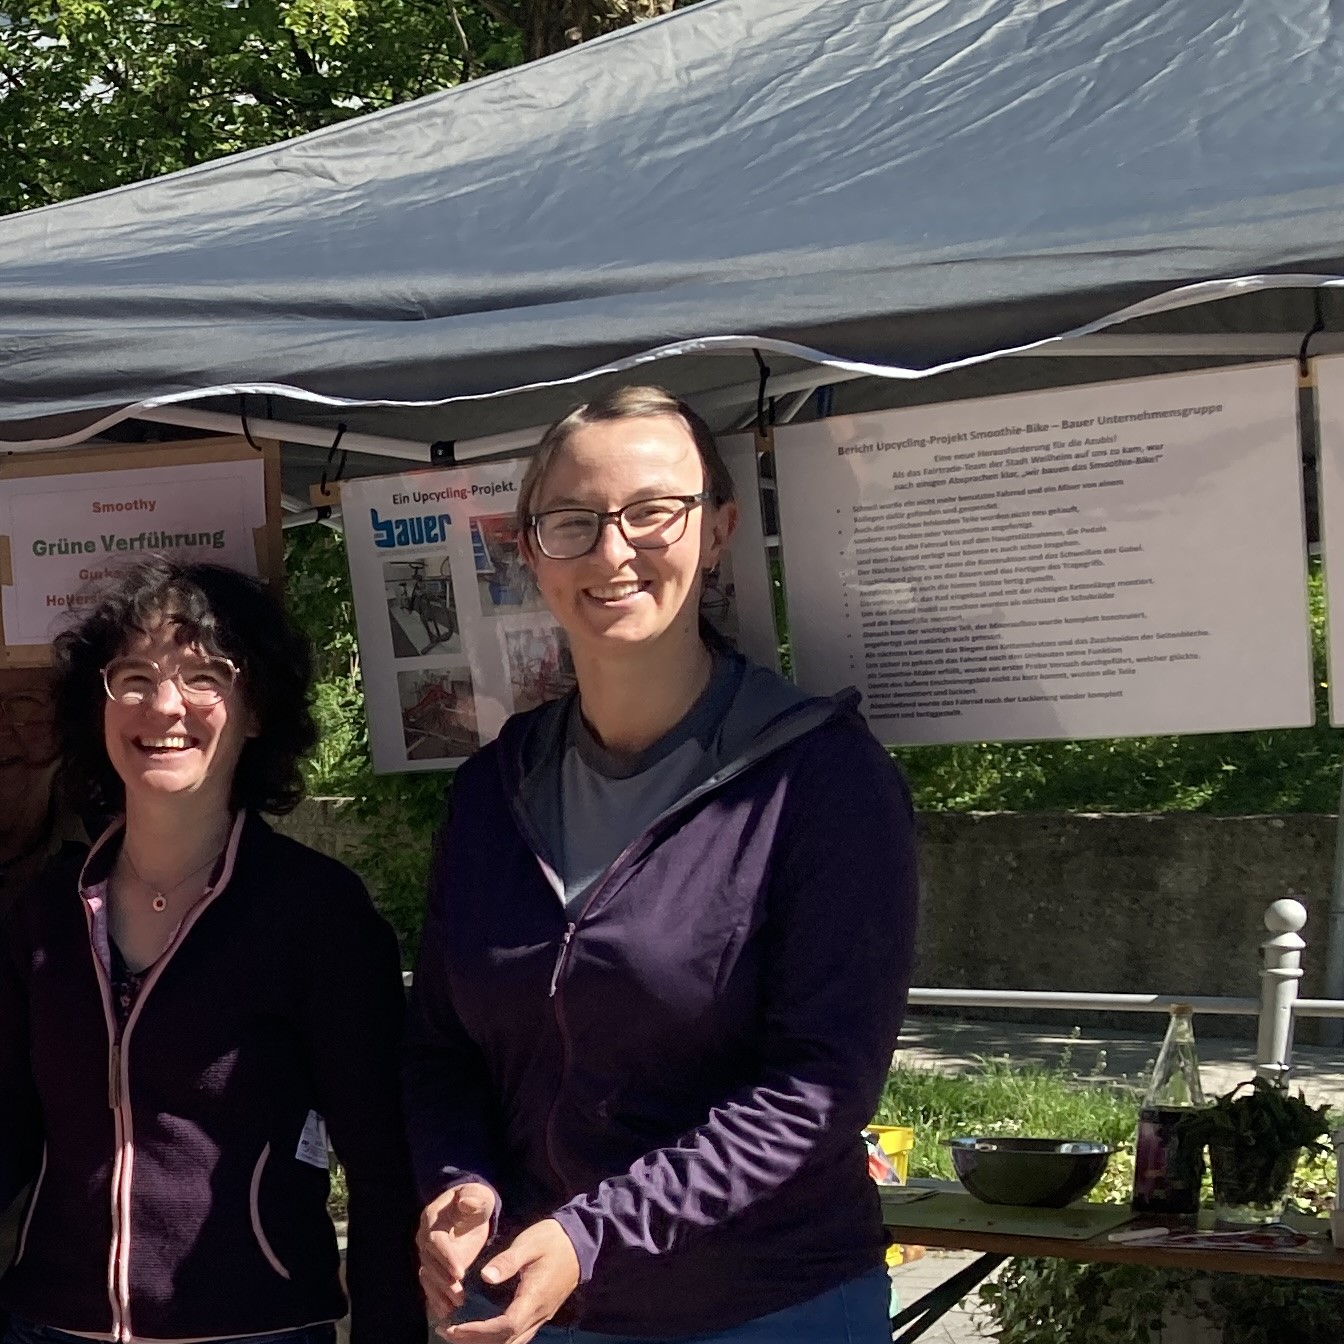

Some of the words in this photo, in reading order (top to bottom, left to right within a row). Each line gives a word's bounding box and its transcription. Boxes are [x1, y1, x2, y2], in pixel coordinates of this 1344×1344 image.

[838, 444, 872, 454] Bericht
[876, 433, 966, 450] Upcycling-Projekt
[970, 424, 1048, 439] Smoothie-Bike
[1061, 419, 1093, 428] Bauer
[1098, 405, 1221, 423] Unternehmensgruppe
[92, 499, 156, 513] Smoothy
[392, 492, 410, 505] Ein
[32, 536, 96, 557] Grüne
[100, 528, 226, 552] Verführung
[370, 508, 452, 549] bauer
